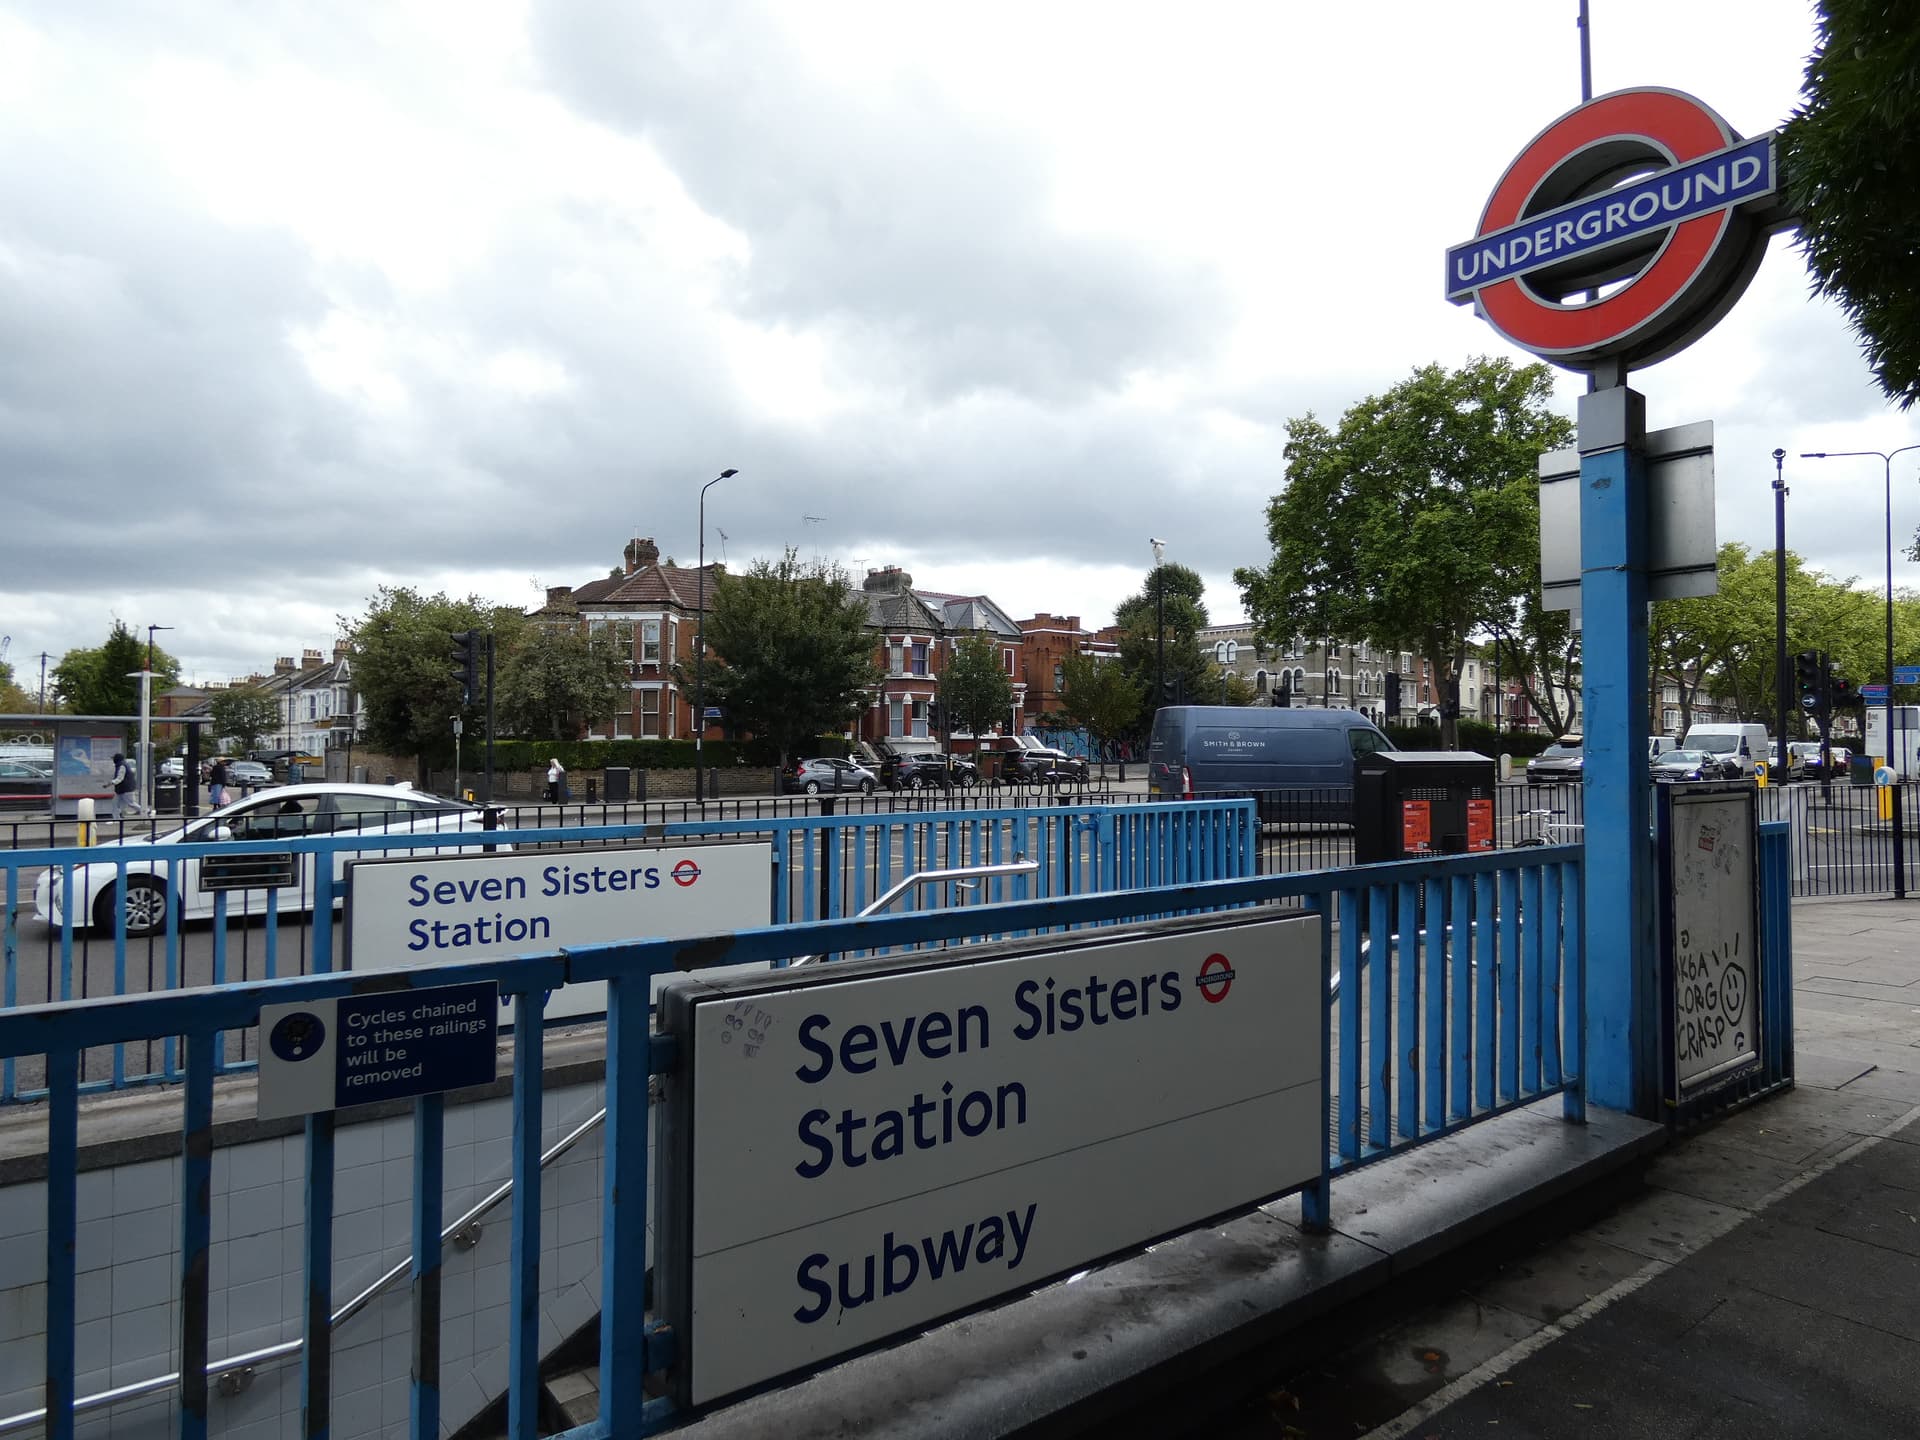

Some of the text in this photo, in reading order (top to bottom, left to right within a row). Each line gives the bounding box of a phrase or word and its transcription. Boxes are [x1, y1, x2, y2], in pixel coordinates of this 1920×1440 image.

[1457, 155, 1762, 281] UNDERGROUND
[408, 865, 661, 907] Seven Sisters
[407, 912, 551, 951] Station
[346, 1018, 487, 1048] to these railings
[347, 1009, 407, 1029] Cycles
[412, 999, 477, 1019] chained
[795, 971, 1182, 1084] Seven Sisters
[346, 1048, 407, 1067] will be
[346, 1063, 423, 1087] removed
[795, 1080, 1027, 1180] Station
[793, 1203, 1038, 1325] Subway
